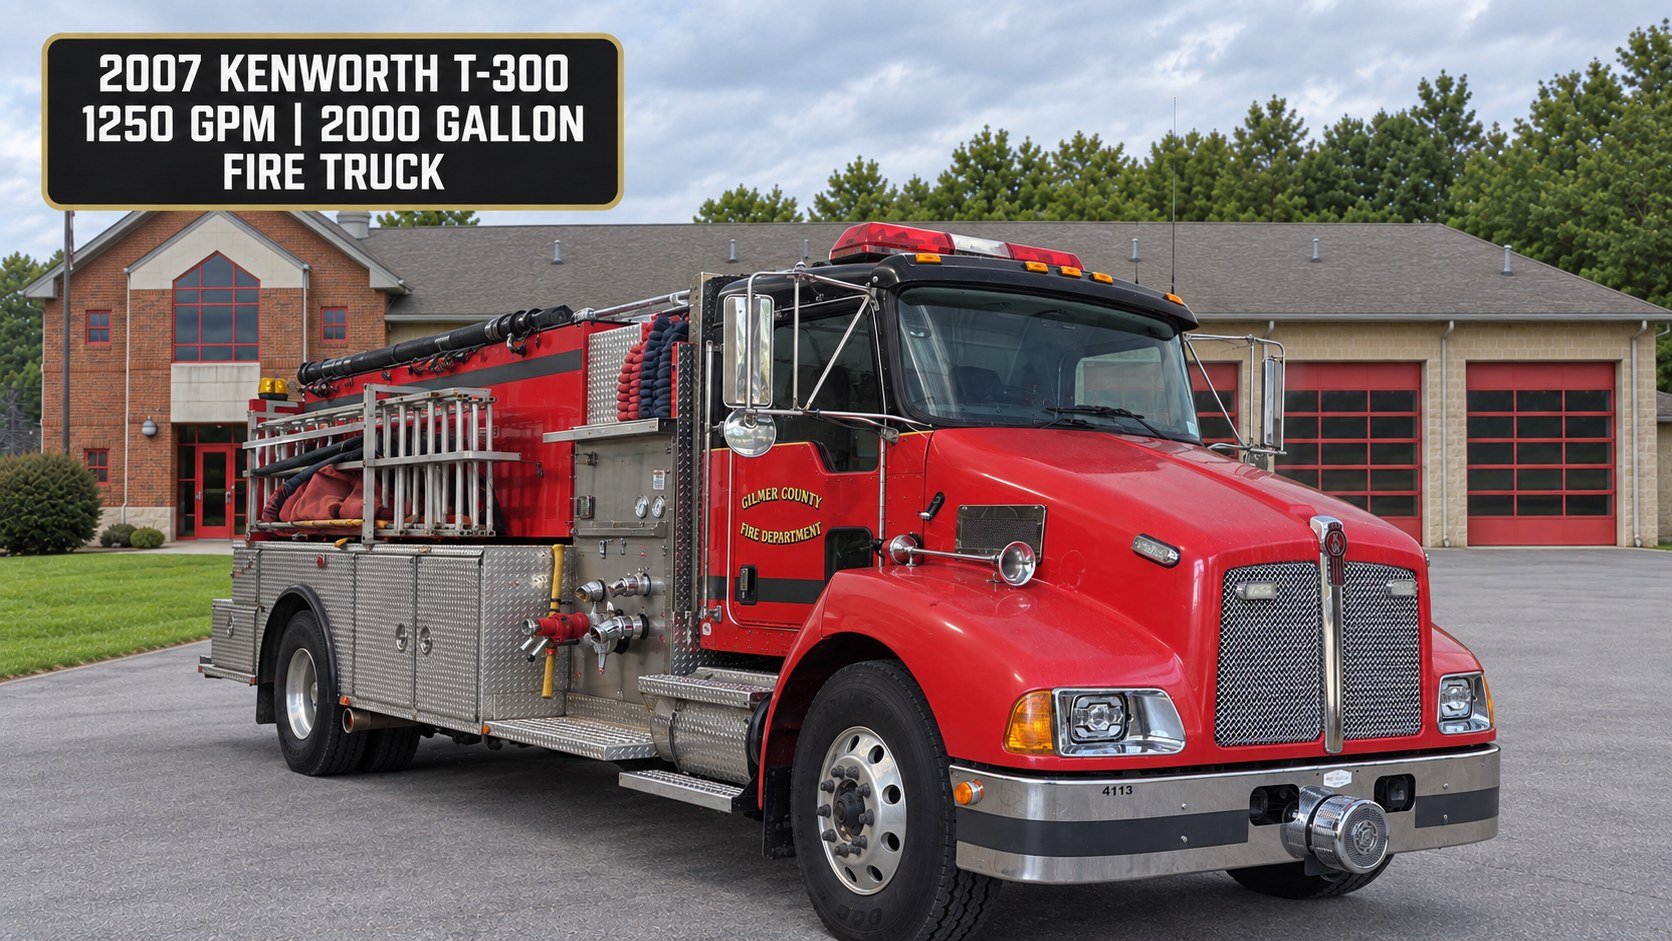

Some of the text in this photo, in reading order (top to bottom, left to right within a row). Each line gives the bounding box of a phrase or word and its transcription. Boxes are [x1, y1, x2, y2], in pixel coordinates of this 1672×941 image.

[741, 487, 822, 509] GILMER COUNTY
[740, 521, 822, 544] FIRE DEPARTMENT
[1102, 785, 1133, 796] 4113
